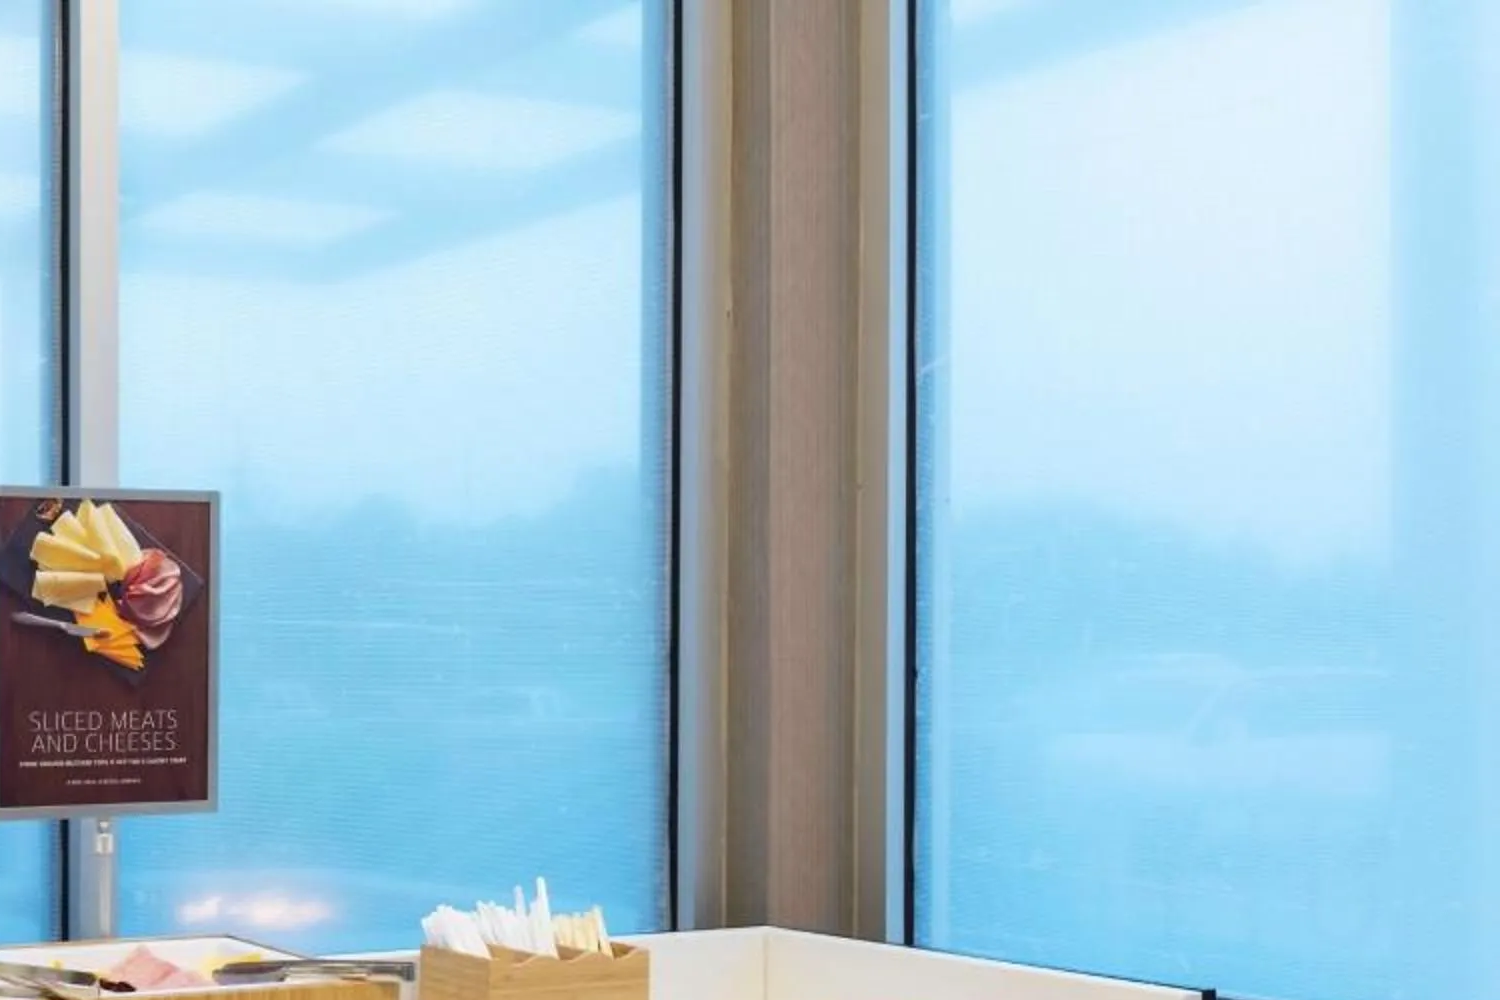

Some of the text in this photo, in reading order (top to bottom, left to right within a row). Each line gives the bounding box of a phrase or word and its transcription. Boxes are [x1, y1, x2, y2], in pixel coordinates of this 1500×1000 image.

[28, 709, 178, 732] SLICED MEATS
[31, 731, 177, 753] AND CHEESES
